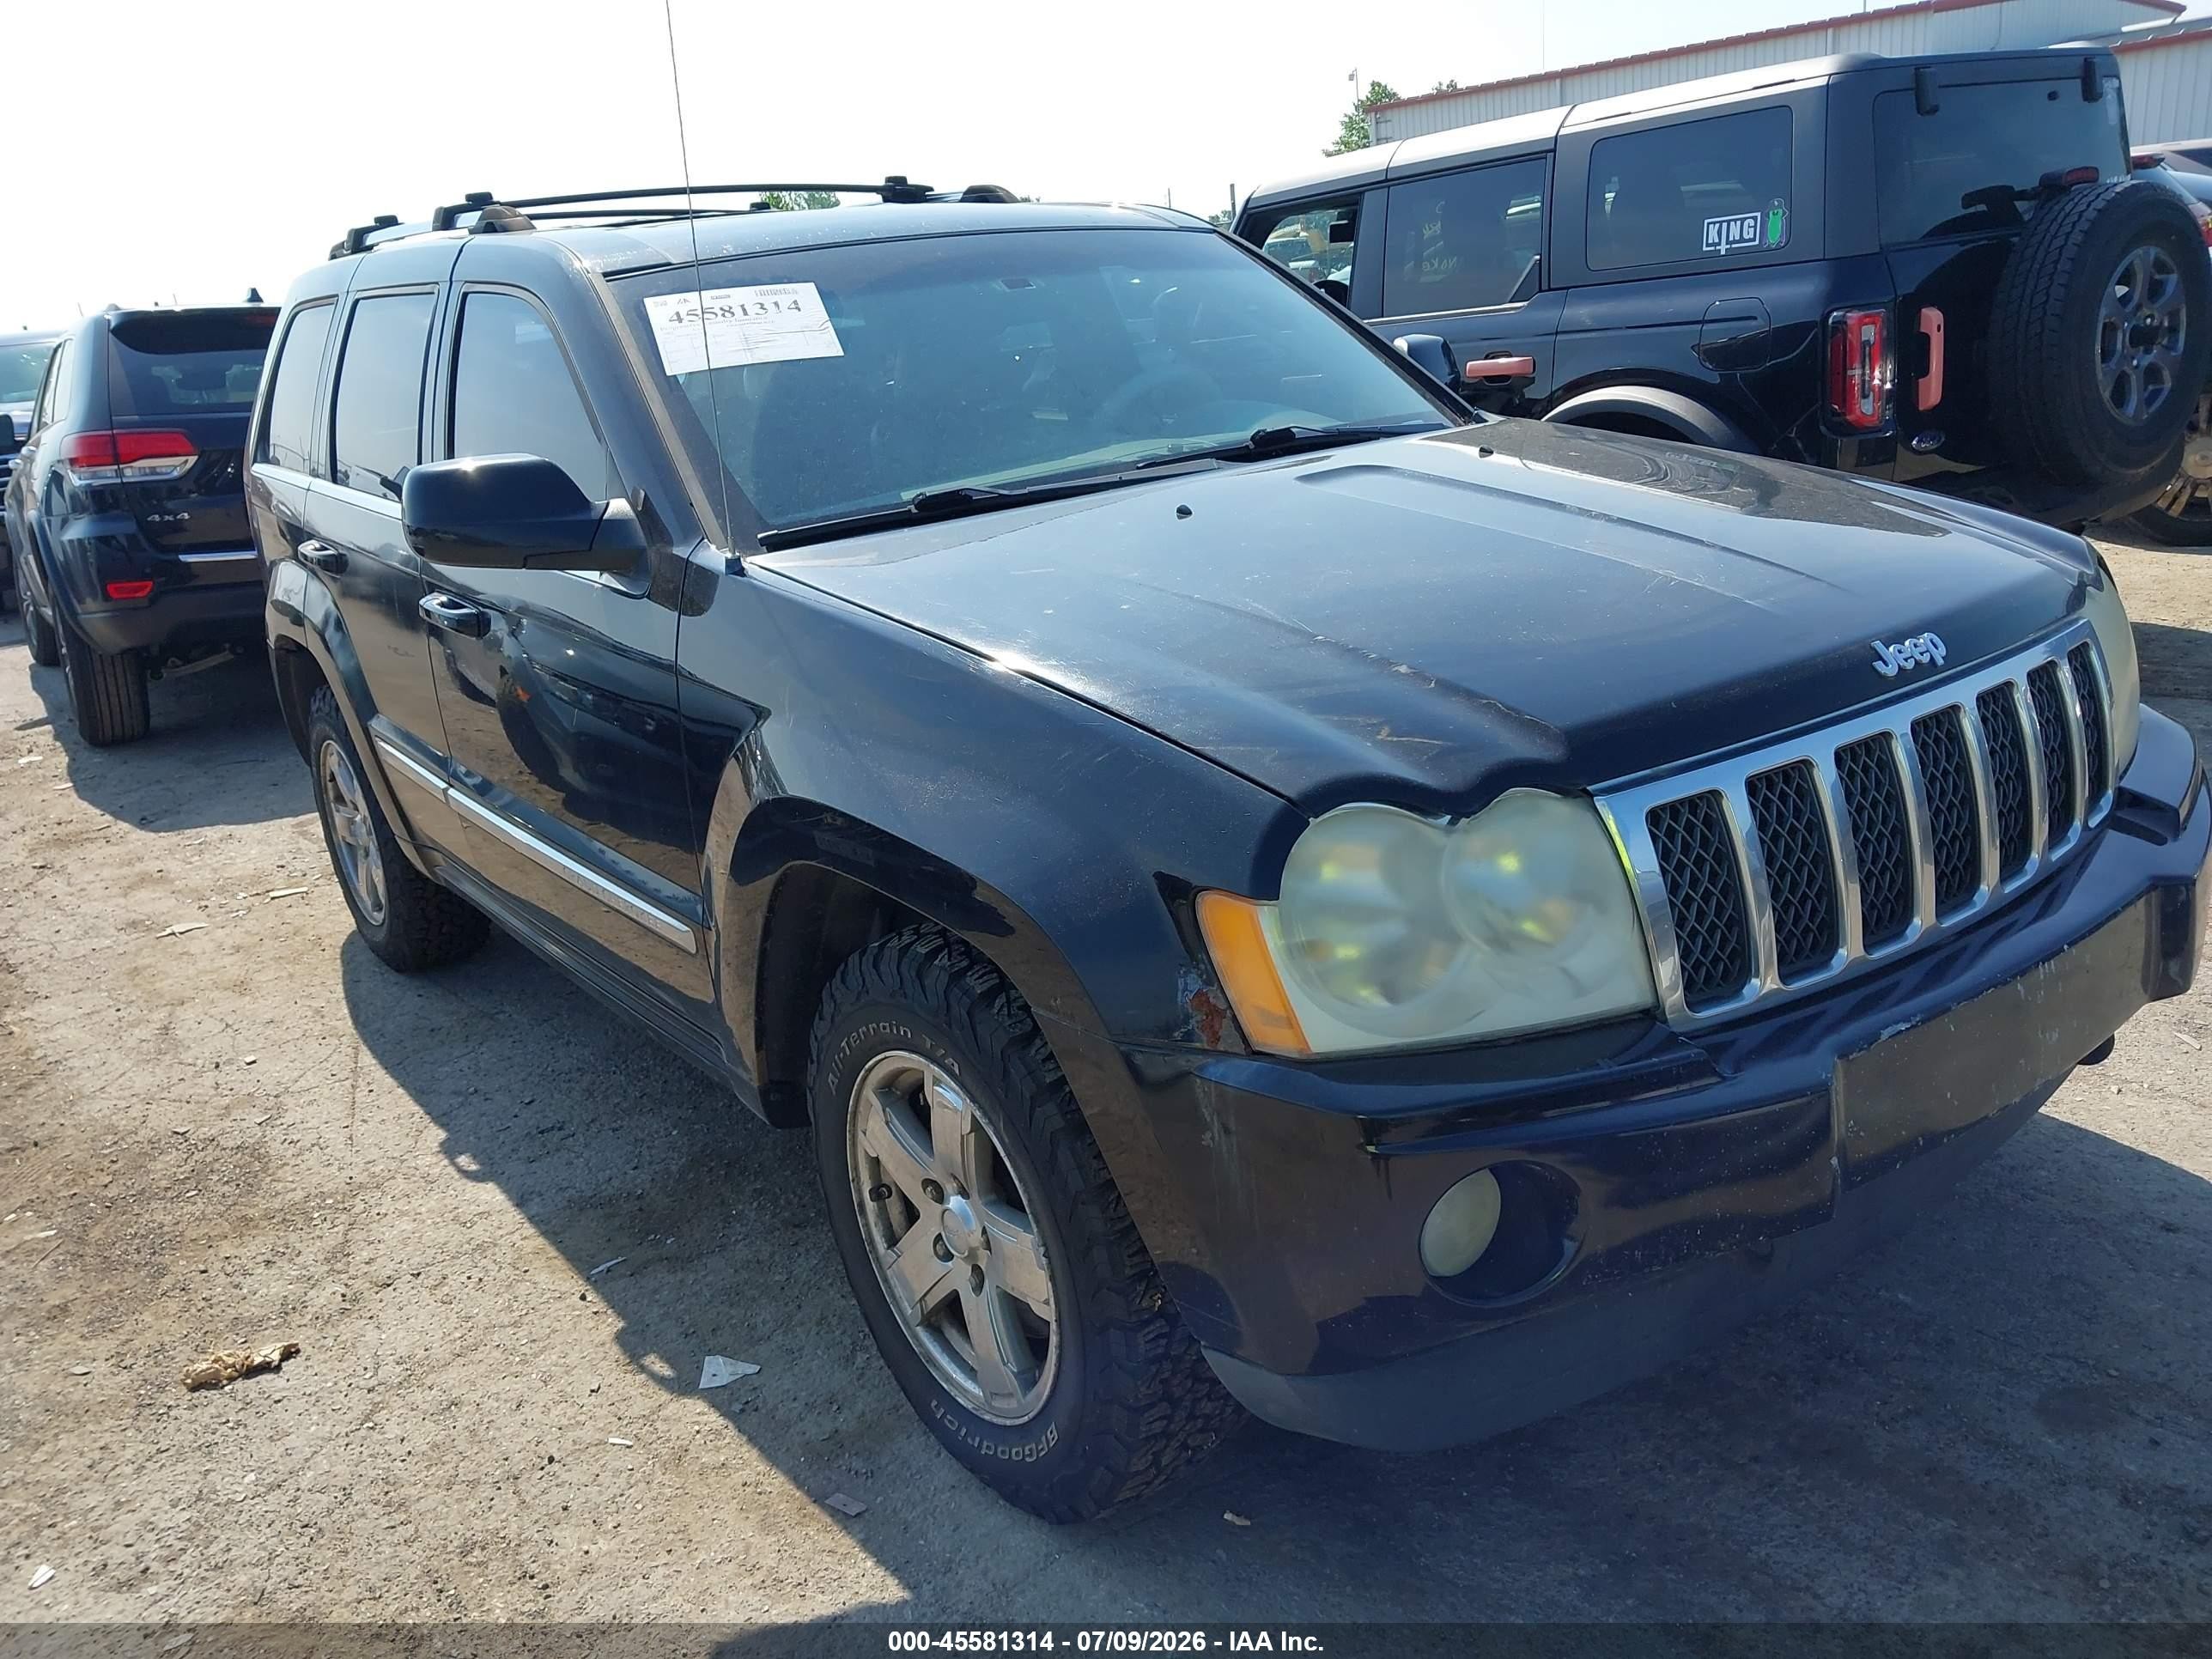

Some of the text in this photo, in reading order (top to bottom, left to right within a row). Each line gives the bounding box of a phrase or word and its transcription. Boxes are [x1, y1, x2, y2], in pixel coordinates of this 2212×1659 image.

[1707, 218, 1755, 255] KING
[668, 299, 801, 324] 45581314
[1870, 632, 1947, 677] Jeep
[930, 1399, 1059, 1462] BFGoodrich
